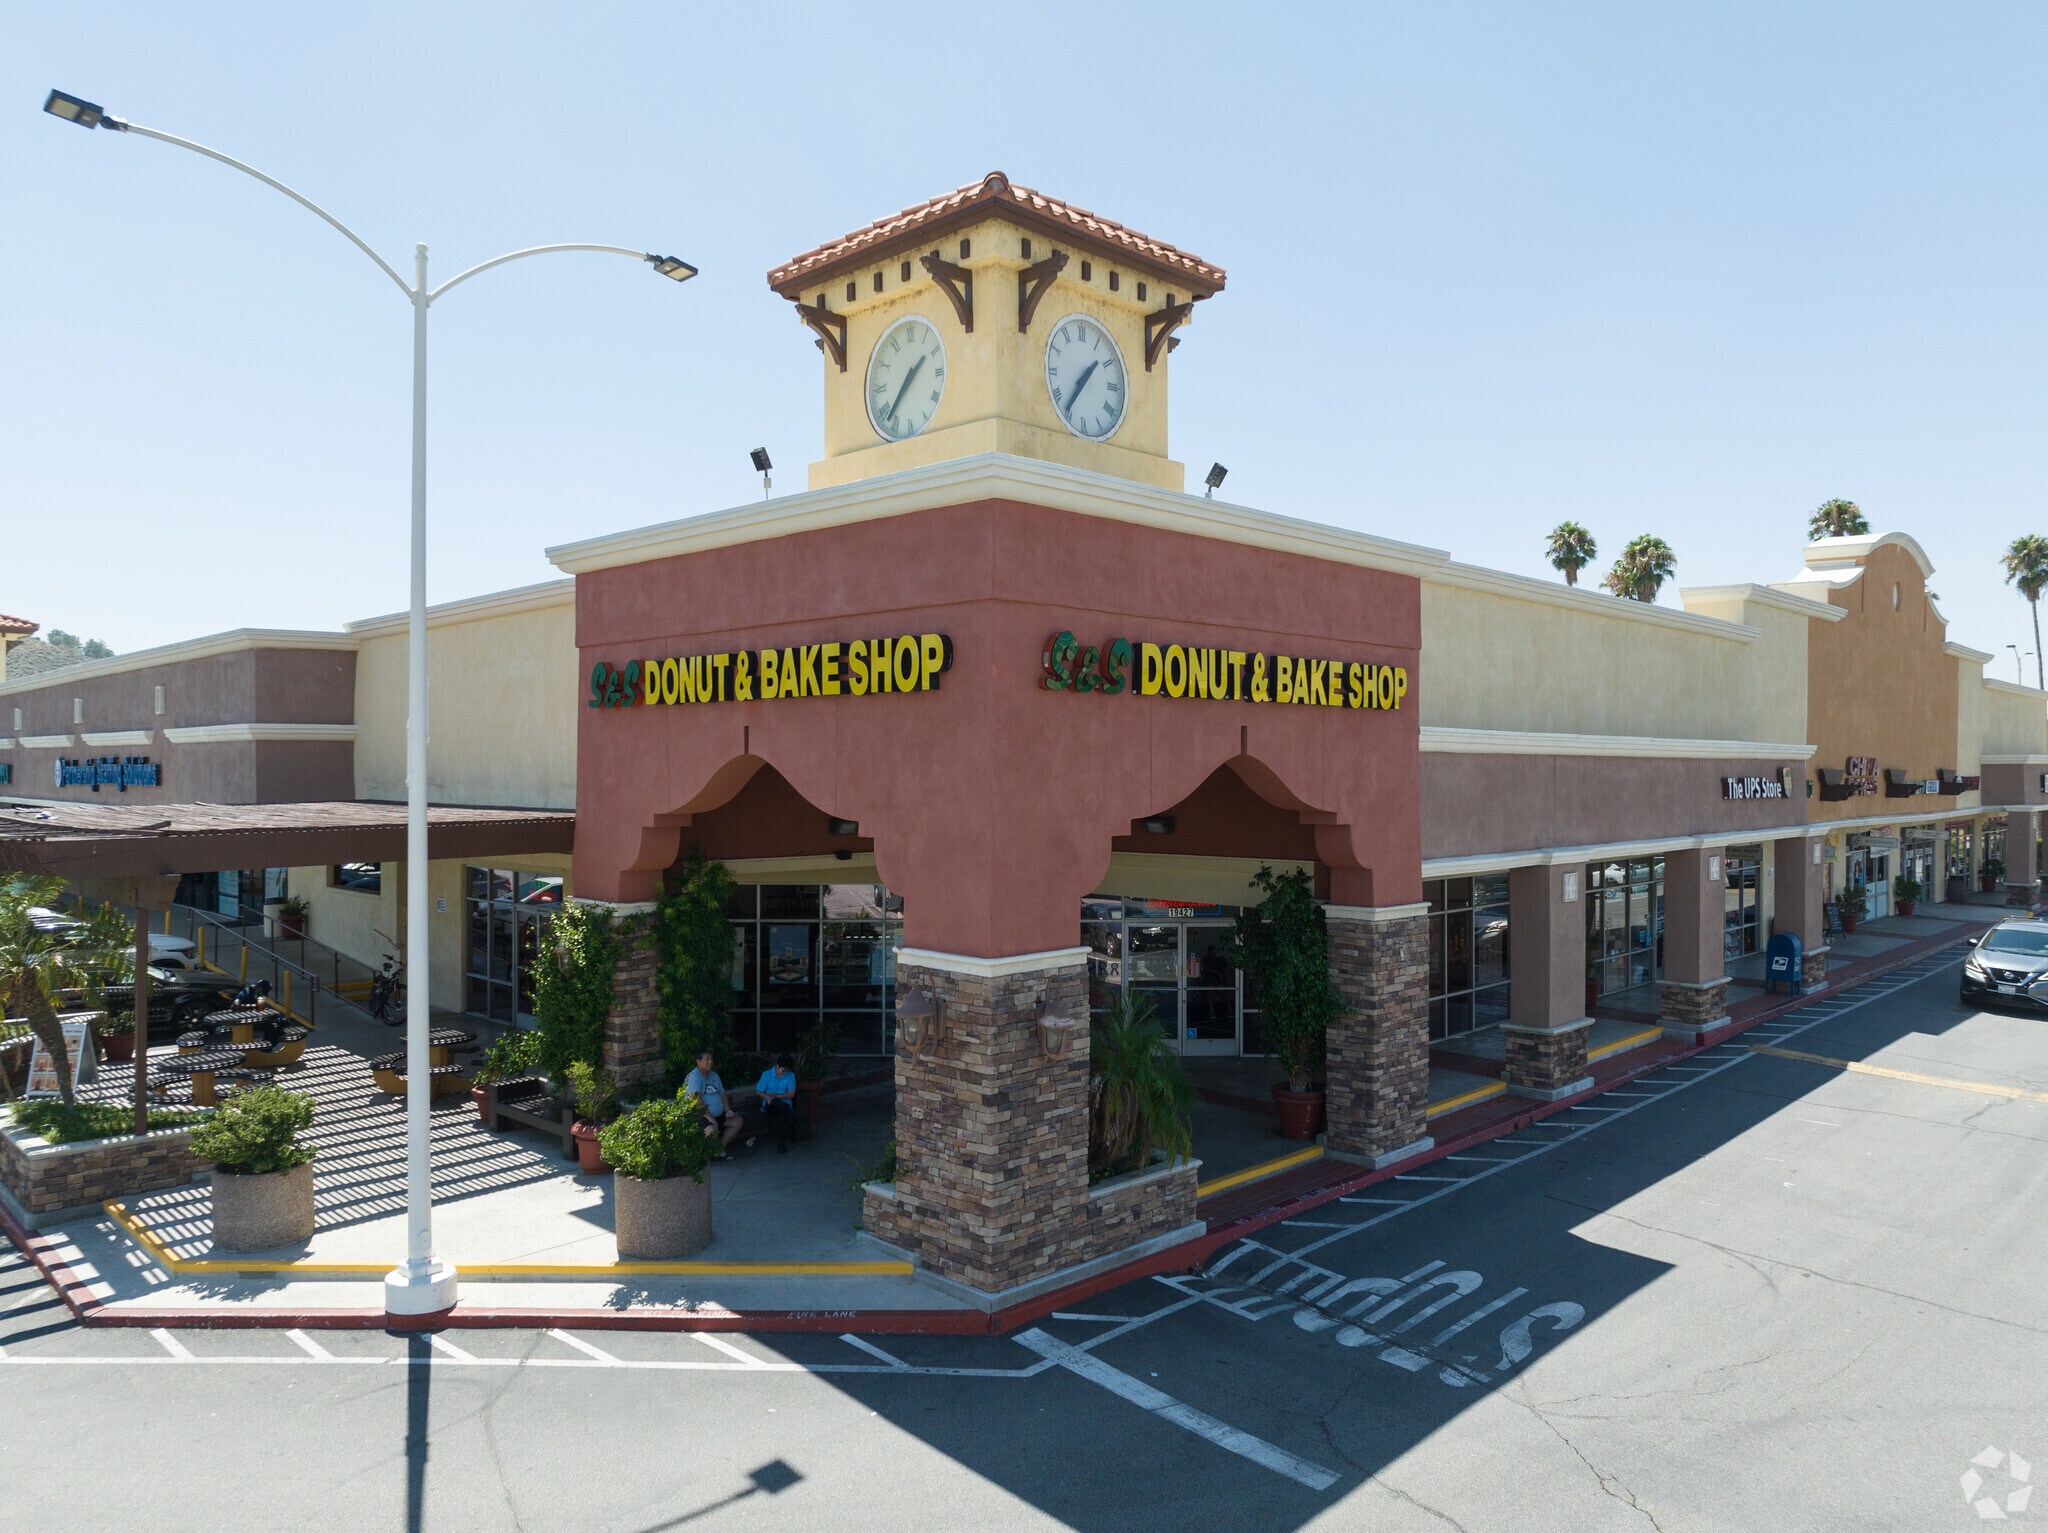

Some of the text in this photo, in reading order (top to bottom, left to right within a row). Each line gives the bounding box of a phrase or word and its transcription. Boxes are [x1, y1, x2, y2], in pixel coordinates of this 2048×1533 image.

[589, 633, 948, 708] S&S DONUT & BAKE SHOP
[1040, 631, 1408, 710] S&S DONUT & BAKE SHOP
[1727, 777, 1743, 800] The
[1744, 777, 1761, 800] UPS
[1761, 776, 1782, 799] Store
[1170, 908, 1194, 917] 19427
[1293, 1260, 1586, 1388] STOP
